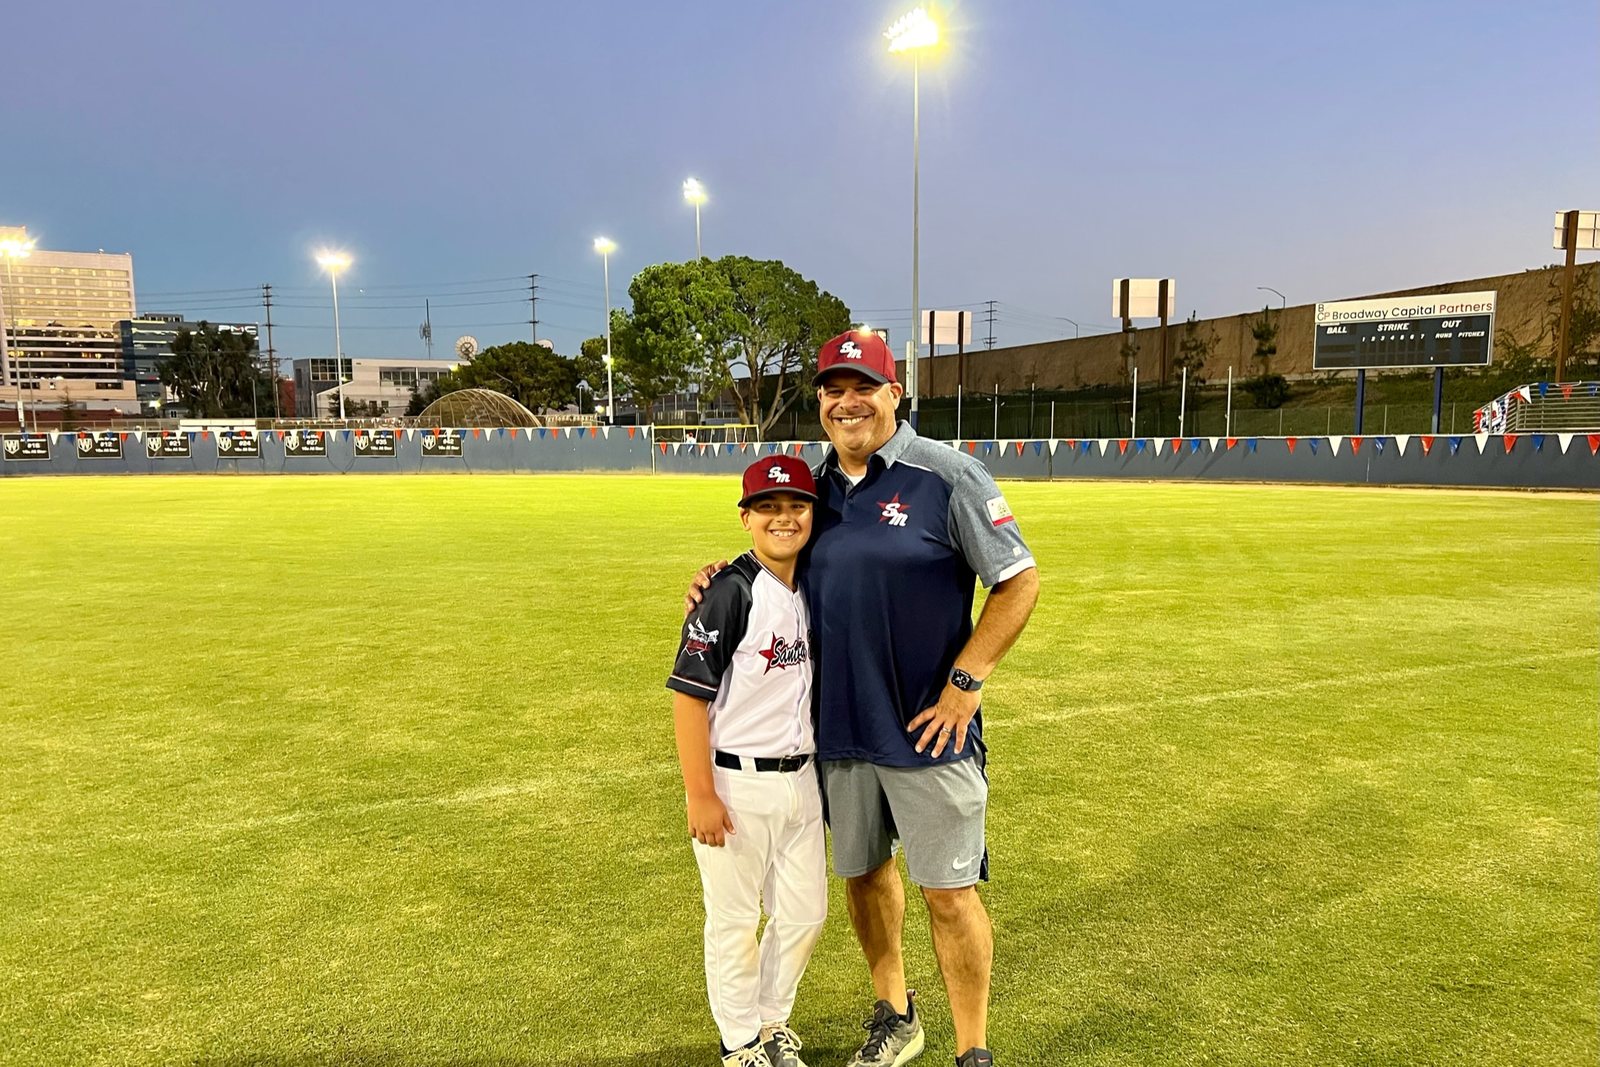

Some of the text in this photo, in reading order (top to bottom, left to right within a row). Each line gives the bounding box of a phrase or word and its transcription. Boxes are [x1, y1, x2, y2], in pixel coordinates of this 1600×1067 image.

[1318, 304, 1324, 312] B
[1332, 303, 1492, 320] Broadway Capital Partners
[1326, 320, 1462, 334] BALL STRIKE OUT
